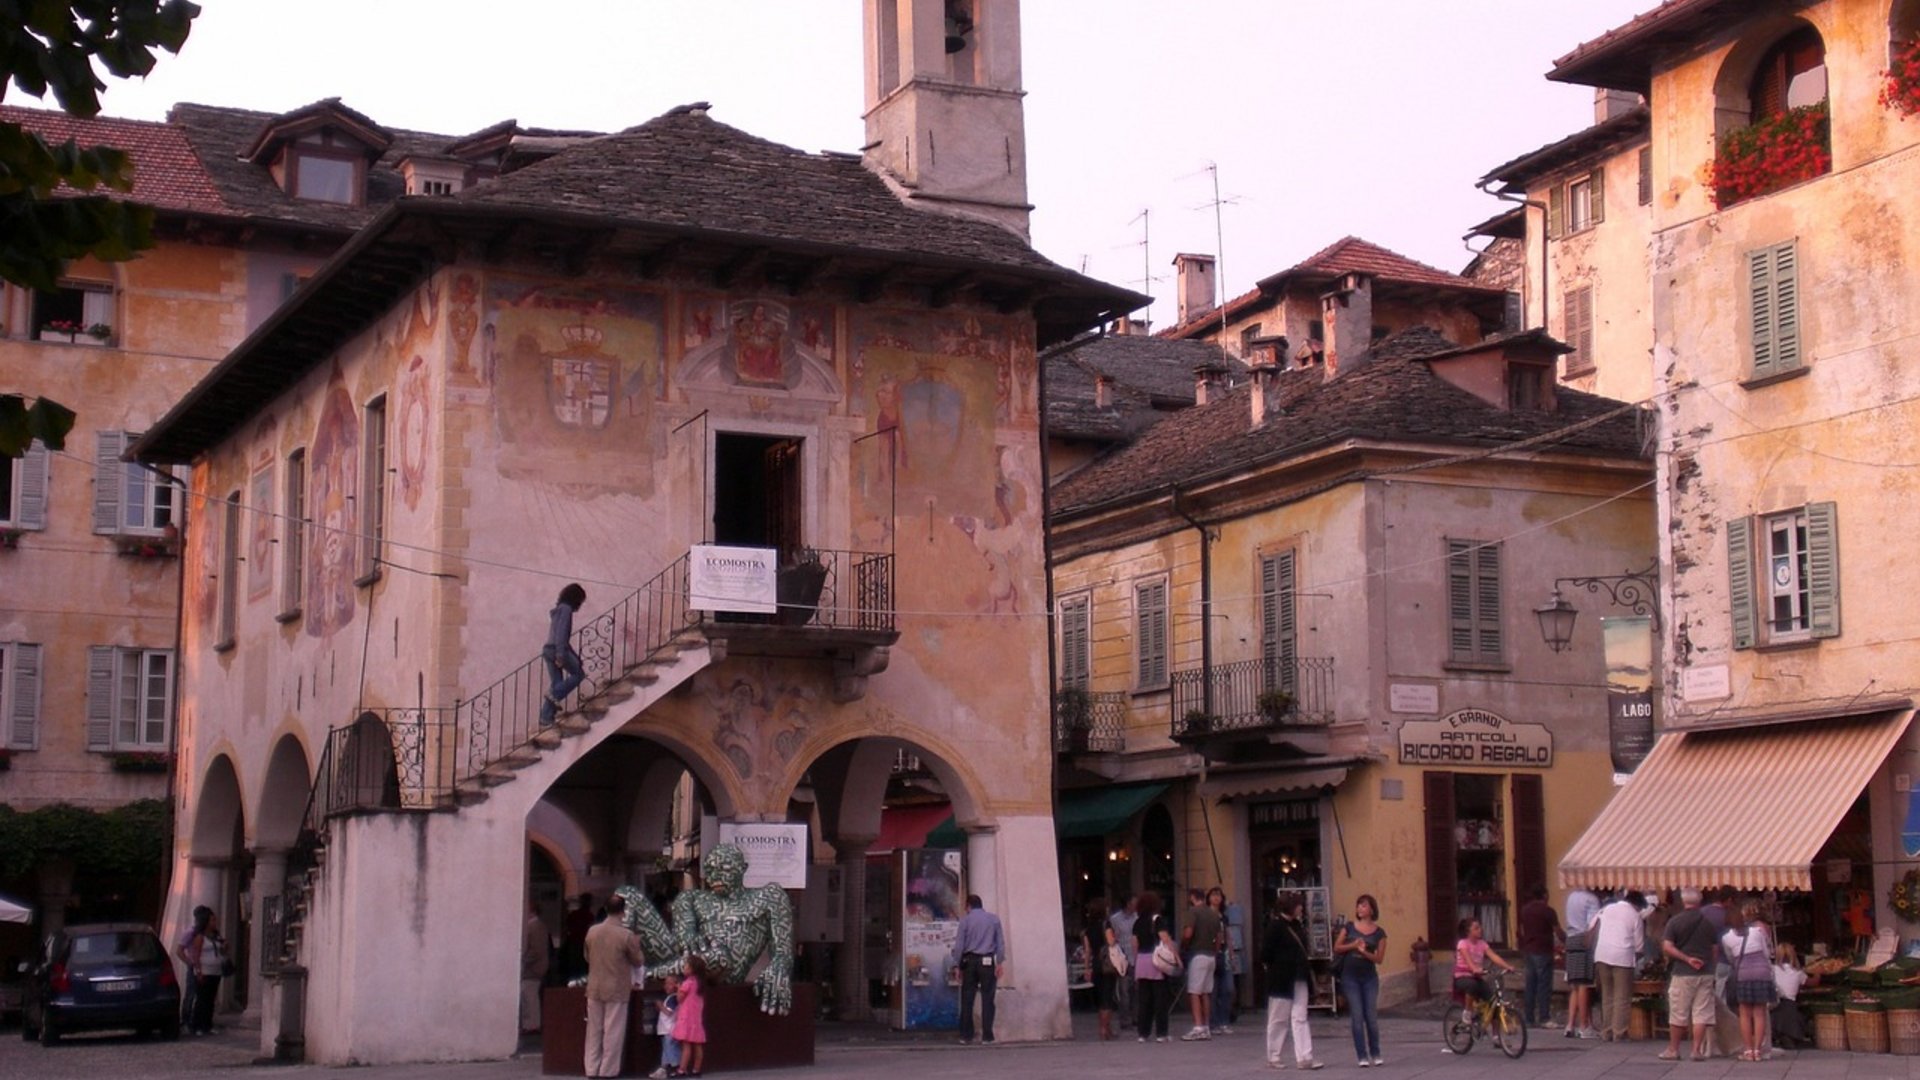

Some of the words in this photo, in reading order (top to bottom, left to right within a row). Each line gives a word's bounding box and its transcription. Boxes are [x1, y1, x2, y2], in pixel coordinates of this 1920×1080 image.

[706, 558, 766, 569] ECOMOSTRA
[1622, 703, 1651, 717] LAGO
[1459, 712, 1502, 729] GRANDI
[1441, 731, 1517, 743] ARTICOLI
[1404, 743, 1475, 760] RICORDO
[1481, 745, 1549, 762] REGALO
[735, 836, 797, 845] ECOMOSTRA
